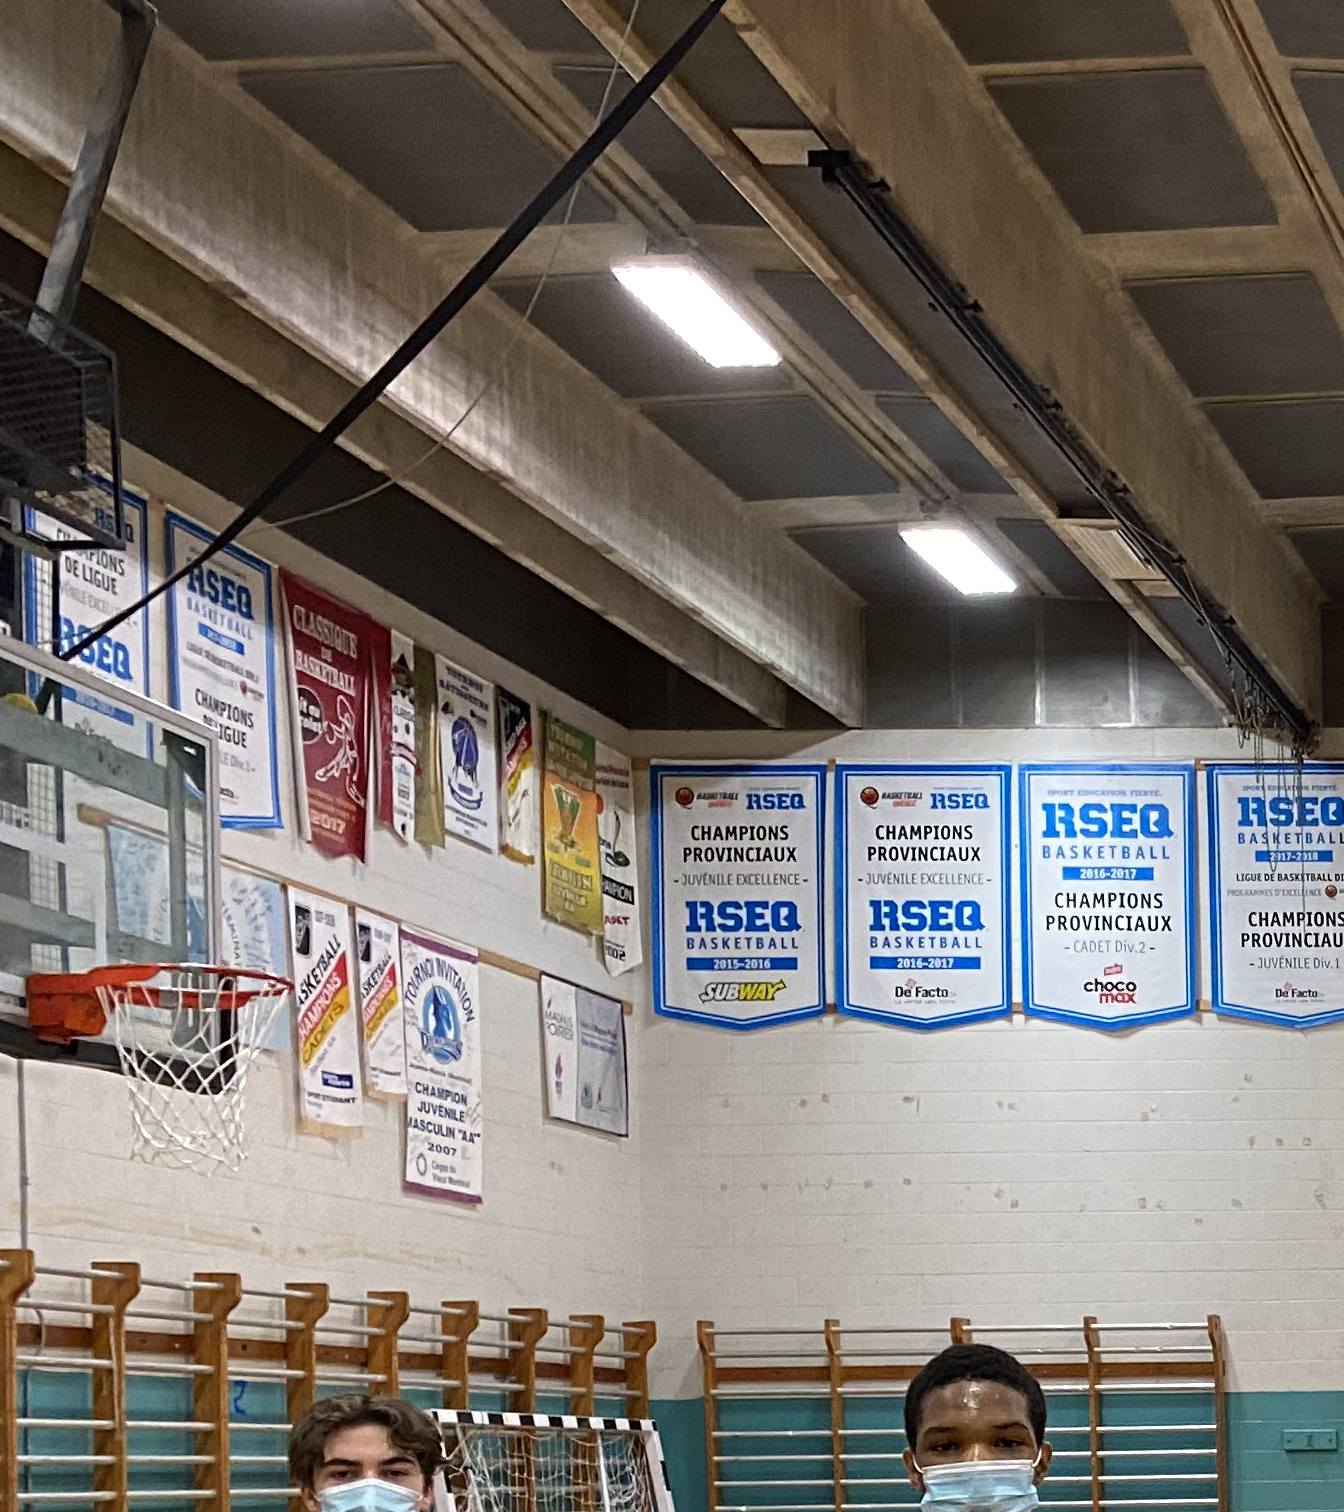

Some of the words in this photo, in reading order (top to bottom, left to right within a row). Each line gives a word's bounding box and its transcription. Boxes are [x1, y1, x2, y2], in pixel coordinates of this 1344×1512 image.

[65, 555, 79, 578] DE
[82, 563, 117, 595] LIGUE
[187, 562, 255, 620] RSEQ
[195, 688, 254, 730] CHAMPIONS
[216, 722, 247, 748] IGUE
[745, 793, 806, 810] RSEQ
[930, 793, 990, 810] RSEQ
[1042, 803, 1174, 838] RSEQ
[691, 825, 789, 841] CHAMPIONS
[875, 824, 973, 840] CHAMPIONS
[683, 846, 797, 862] PROVINCIAUX
[867, 846, 981, 862] PROVINCIAUX
[1042, 845, 1170, 859] BASKETBALL
[681, 872, 733, 886] JUVÉNILE
[736, 873, 800, 886] EXCELLENCE
[865, 872, 917, 885] JUVÉNILE
[920, 873, 983, 885] EXCELLENCE
[1080, 868, 1136, 879] 2016-2017
[1236, 873, 1262, 882] LIGUE
[1264, 873, 1275, 882] DE
[1277, 873, 1333, 882] BASKETBALL
[1054, 892, 1163, 908] CHAMPIONS
[685, 901, 802, 932] RSEQ
[869, 900, 986, 931] RSEQ
[1046, 915, 1172, 931] PROVINCIAUX
[686, 937, 798, 950] BASKETBALL
[870, 936, 982, 949] BASKETBALL
[1073, 940, 1110, 953] CADET
[1115, 941, 1146, 954] Div.2
[298, 934, 342, 1005] ASKETBALL
[713, 958, 771, 970] 2015-2016
[896, 958, 954, 969] 2016-2017
[1257, 955, 1310, 969] JUVÉNILE
[1313, 957, 1340, 969] Div.1
[404, 957, 435, 1006] TOURNOI
[435, 957, 475, 1023] INVITATION
[698, 979, 787, 1003] SUBWAY
[895, 986, 912, 997] De
[915, 986, 949, 997] Facto
[1083, 978, 1137, 992] choco
[1275, 988, 1289, 998] De
[1291, 988, 1318, 998] Facto
[299, 970, 342, 1042] HAMPIONS
[1099, 993, 1137, 1004] max
[415, 1081, 468, 1106] CHAMPION
[427, 1141, 457, 1156] 2007
